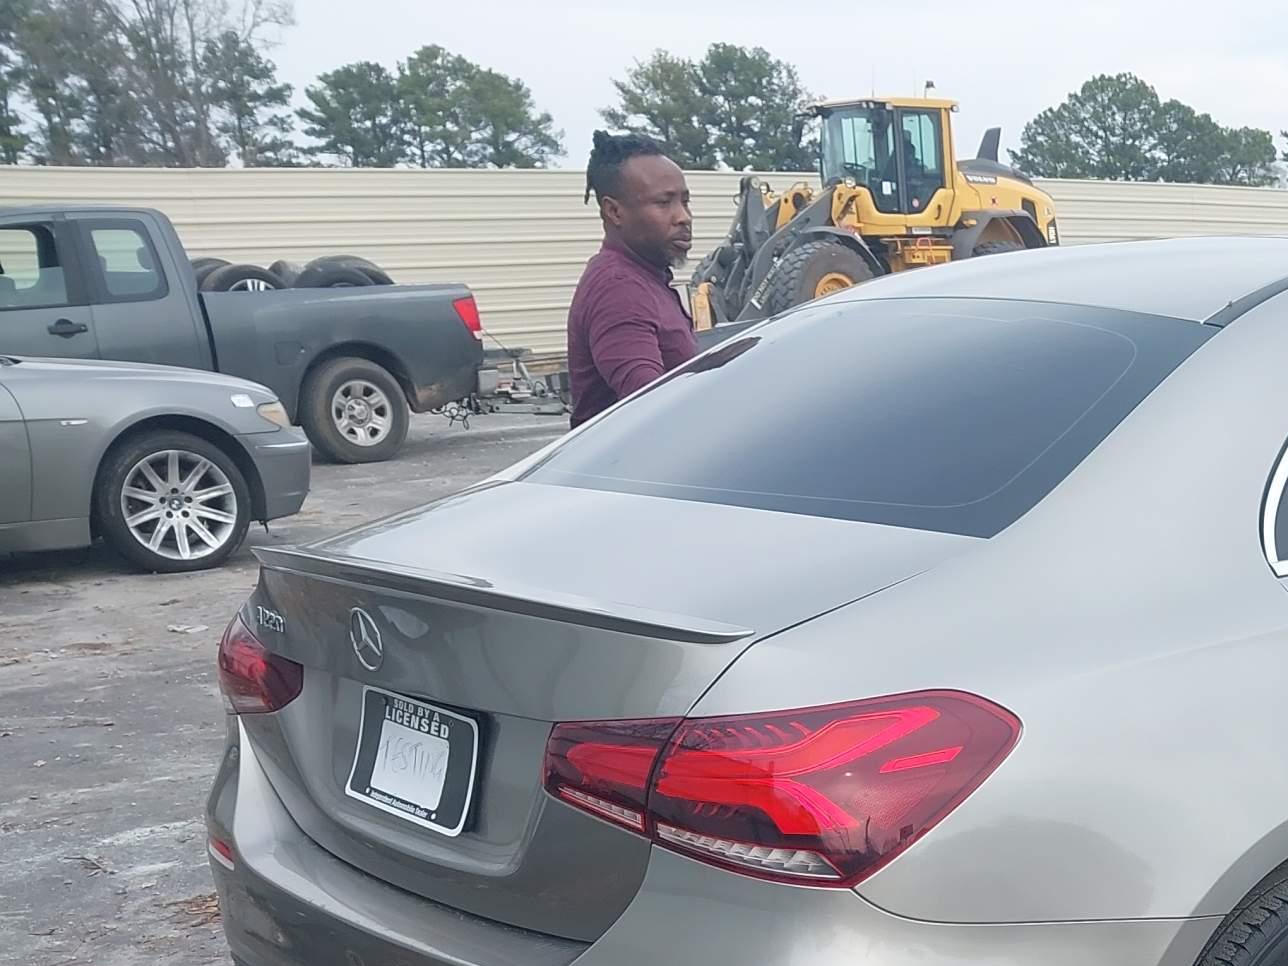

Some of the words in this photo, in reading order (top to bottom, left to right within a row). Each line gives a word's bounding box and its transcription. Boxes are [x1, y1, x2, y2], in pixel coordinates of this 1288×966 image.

[385, 705, 449, 739] LICENSED
[393, 699, 413, 714] SOLD
[417, 707, 429, 718] BY
[433, 712, 440, 722] A
